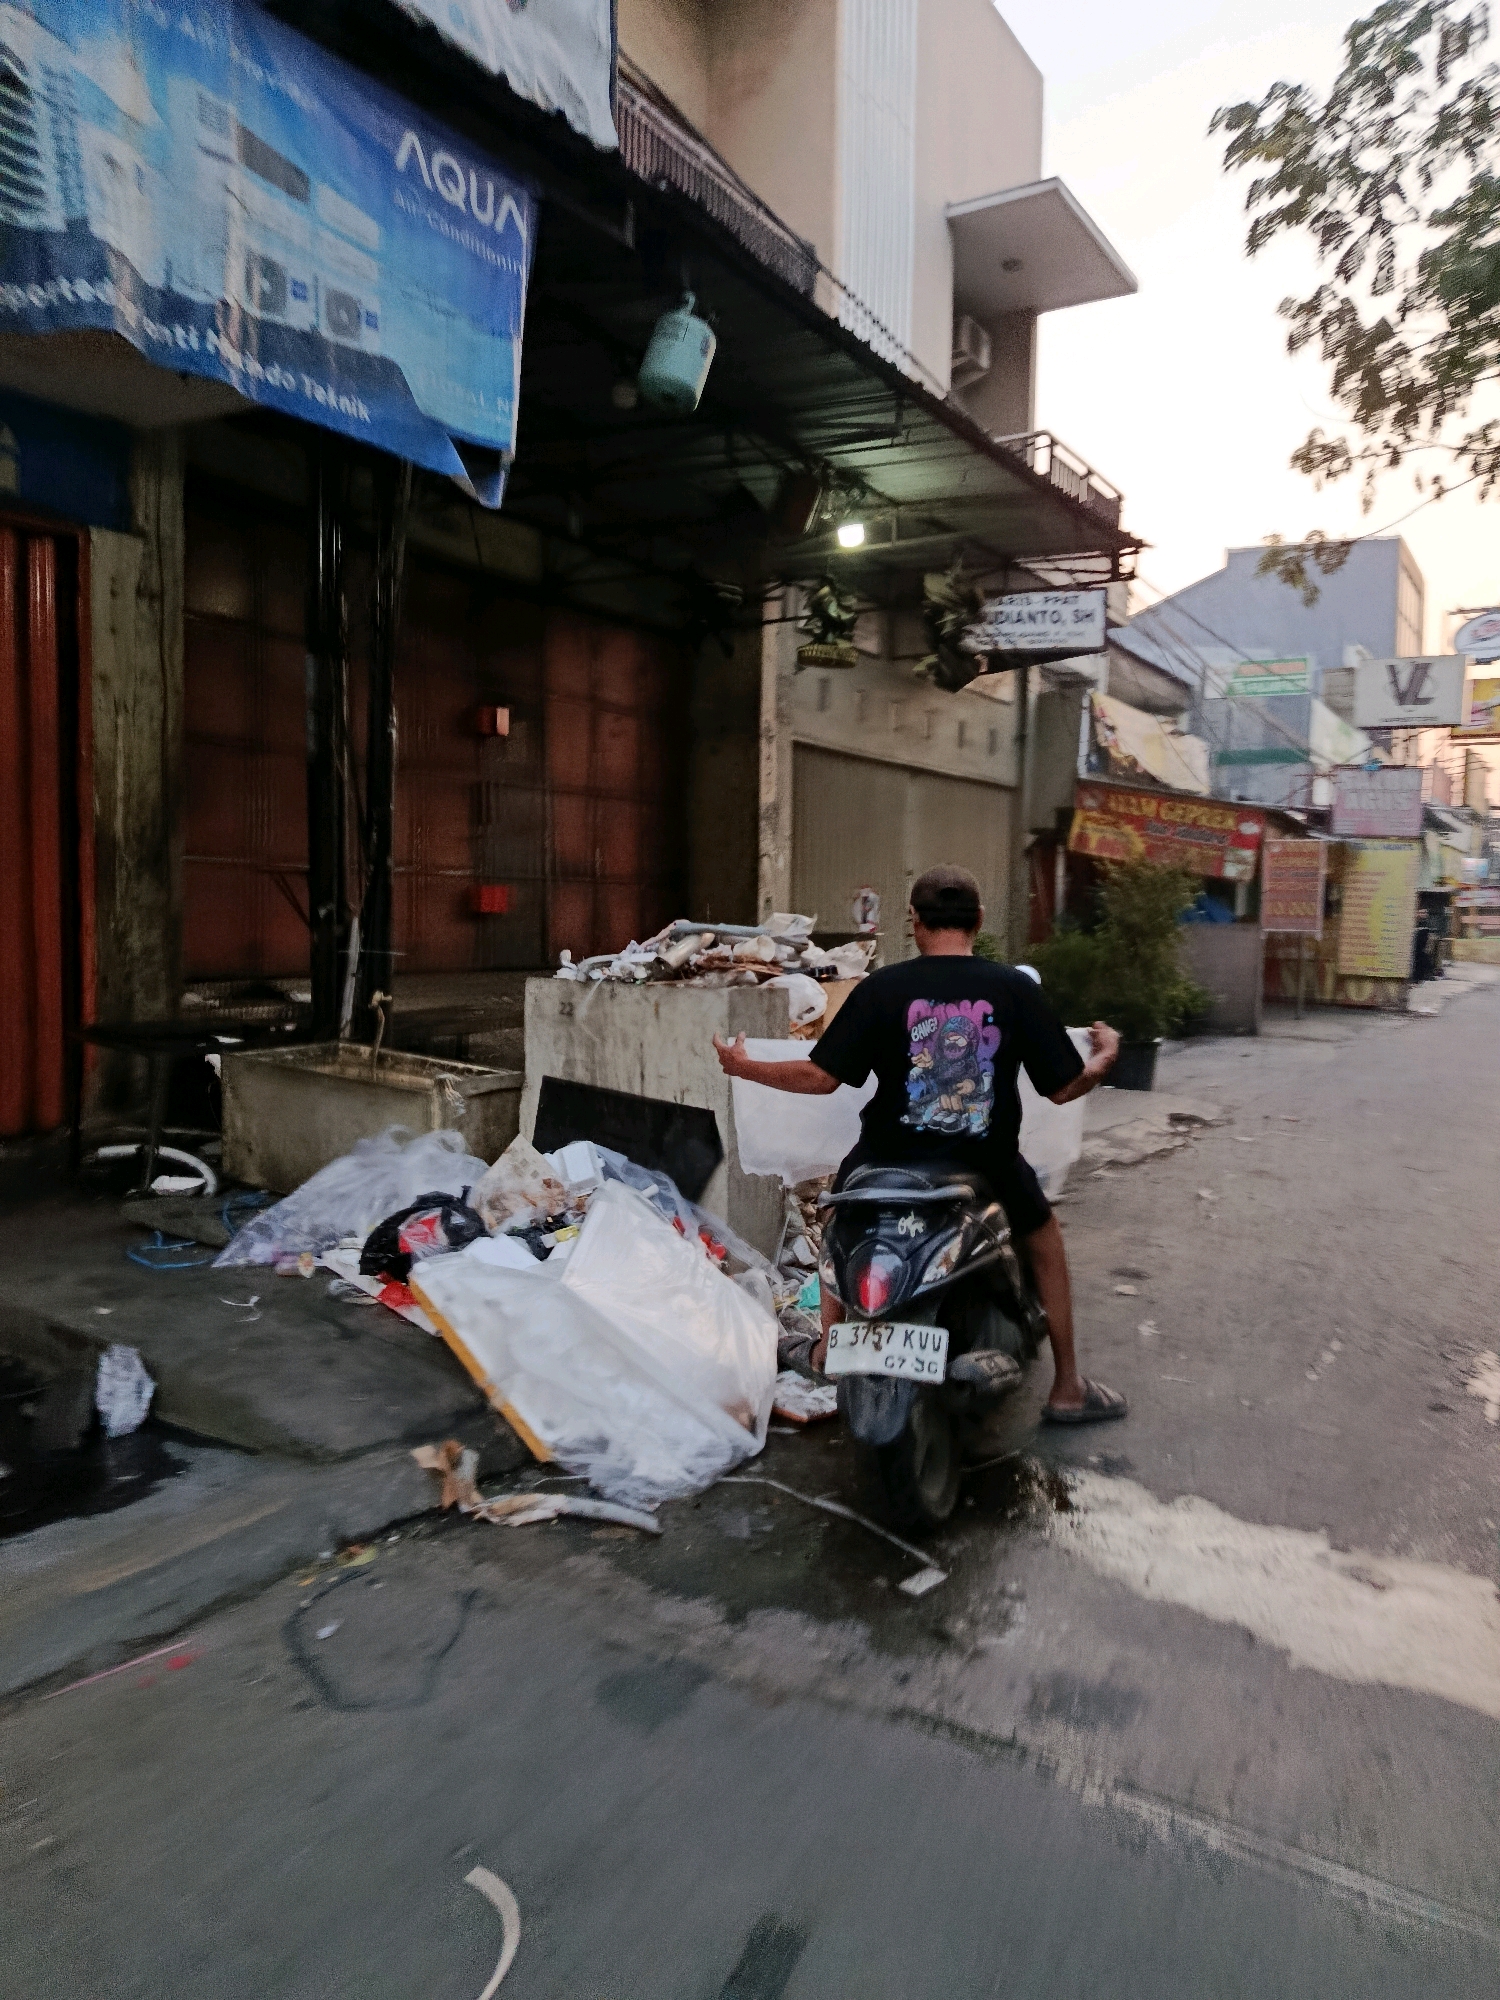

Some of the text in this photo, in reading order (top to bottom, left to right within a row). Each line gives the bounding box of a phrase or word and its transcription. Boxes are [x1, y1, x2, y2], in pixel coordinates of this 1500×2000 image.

[396, 131, 527, 240] AQUA
[911, 1017, 938, 1042] BANG!
[829, 1329, 839, 1349] B
